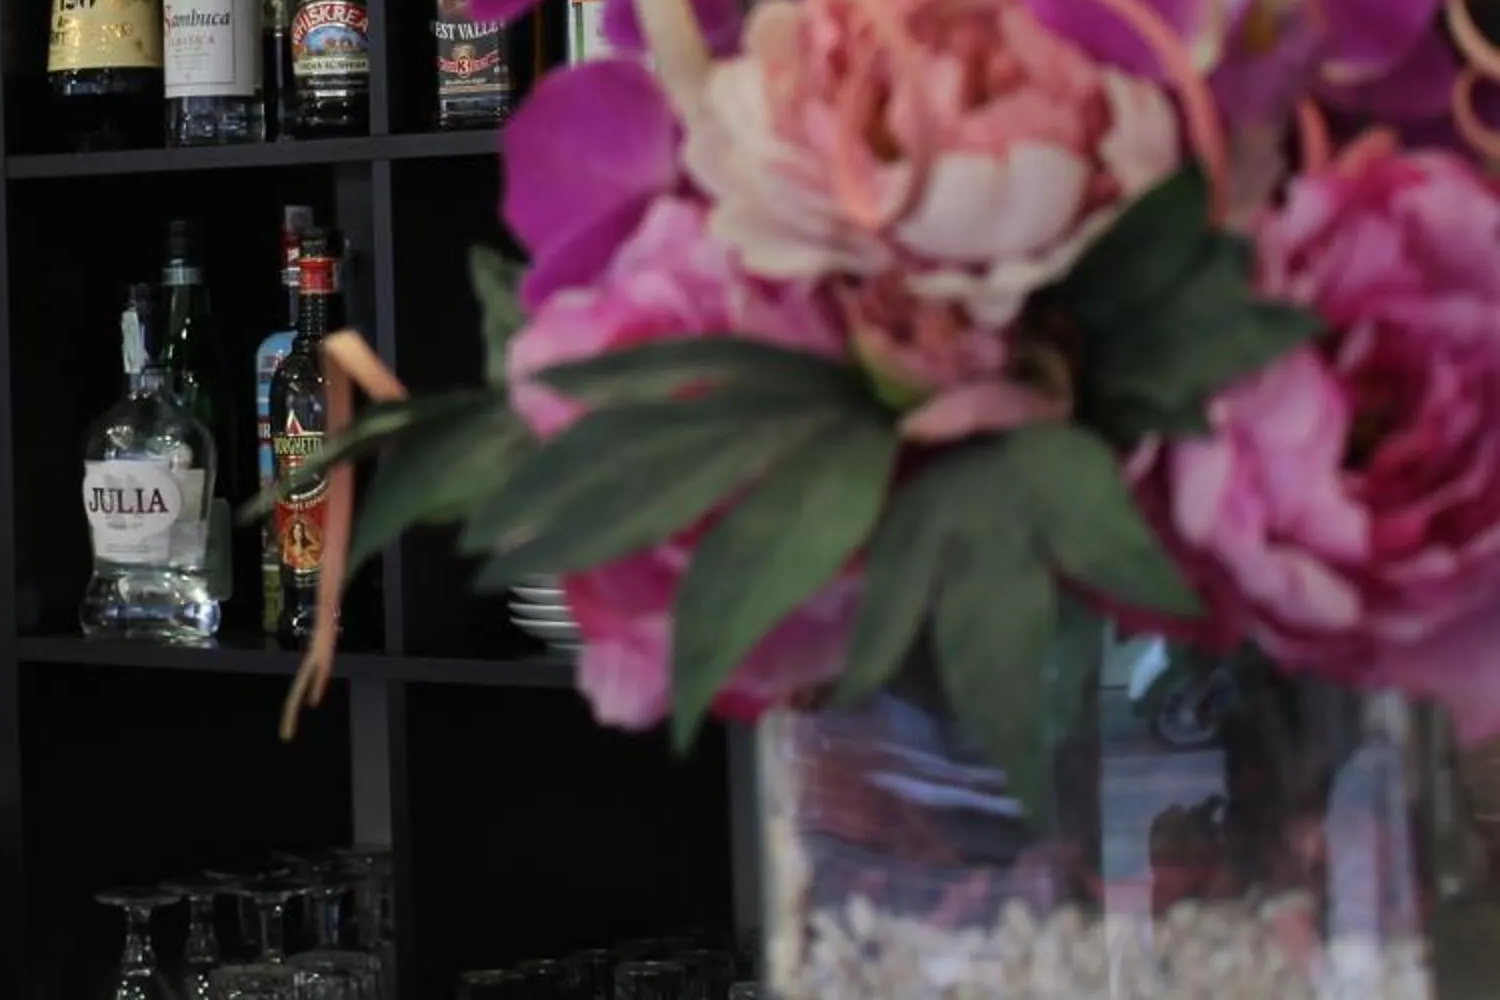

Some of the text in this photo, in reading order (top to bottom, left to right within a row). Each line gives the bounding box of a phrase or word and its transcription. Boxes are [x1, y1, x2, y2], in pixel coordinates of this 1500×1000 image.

[431, 20, 504, 40] EST VALLE
[88, 487, 169, 514] JULIA
